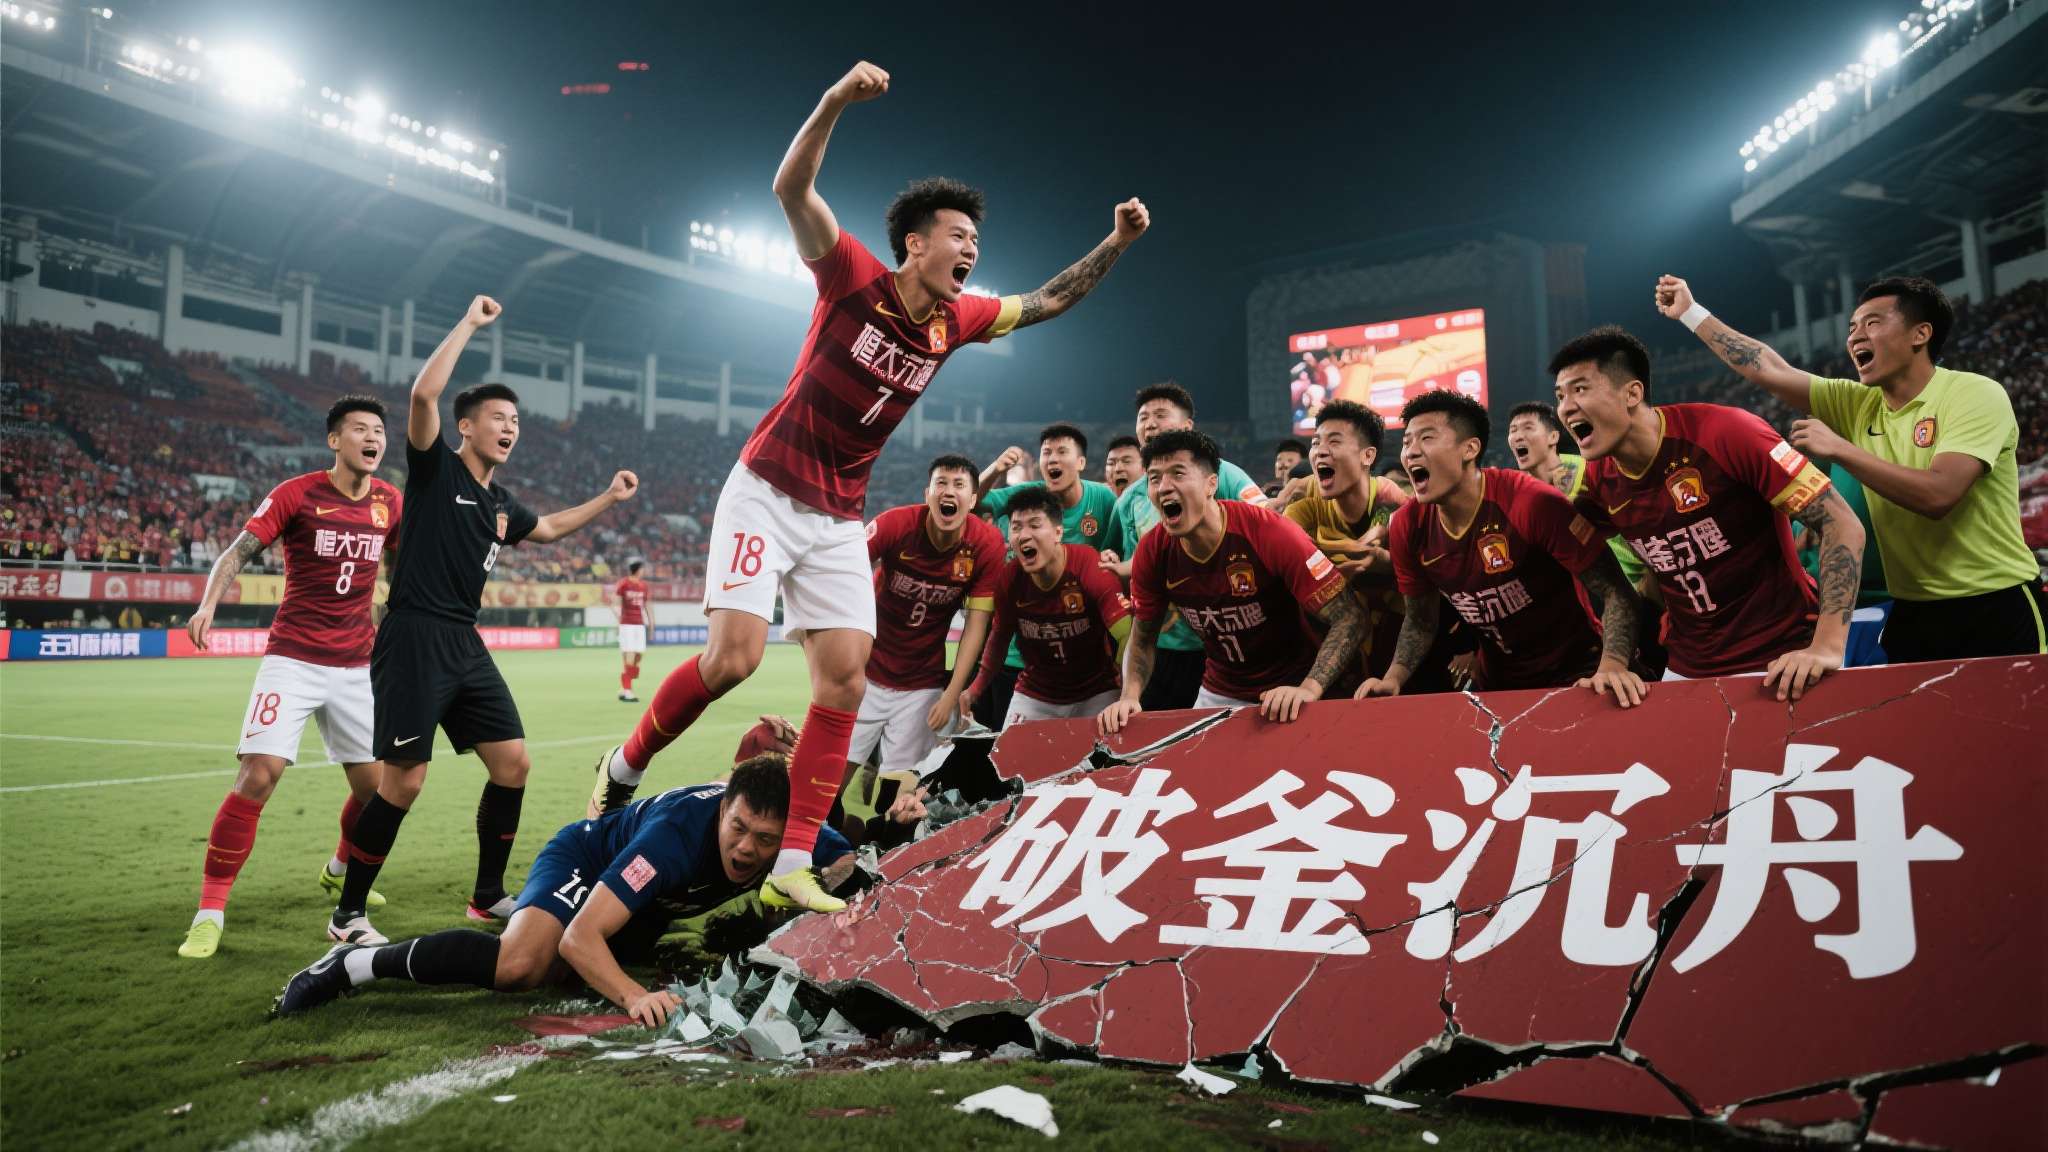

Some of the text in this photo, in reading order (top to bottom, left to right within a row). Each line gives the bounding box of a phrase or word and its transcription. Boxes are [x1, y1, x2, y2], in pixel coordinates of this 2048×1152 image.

[860, 385, 894, 425] 7
[335, 561, 355, 595] 8
[250, 692, 281, 726] 18
[958, 744, 1964, 980] 破釜沉舟
